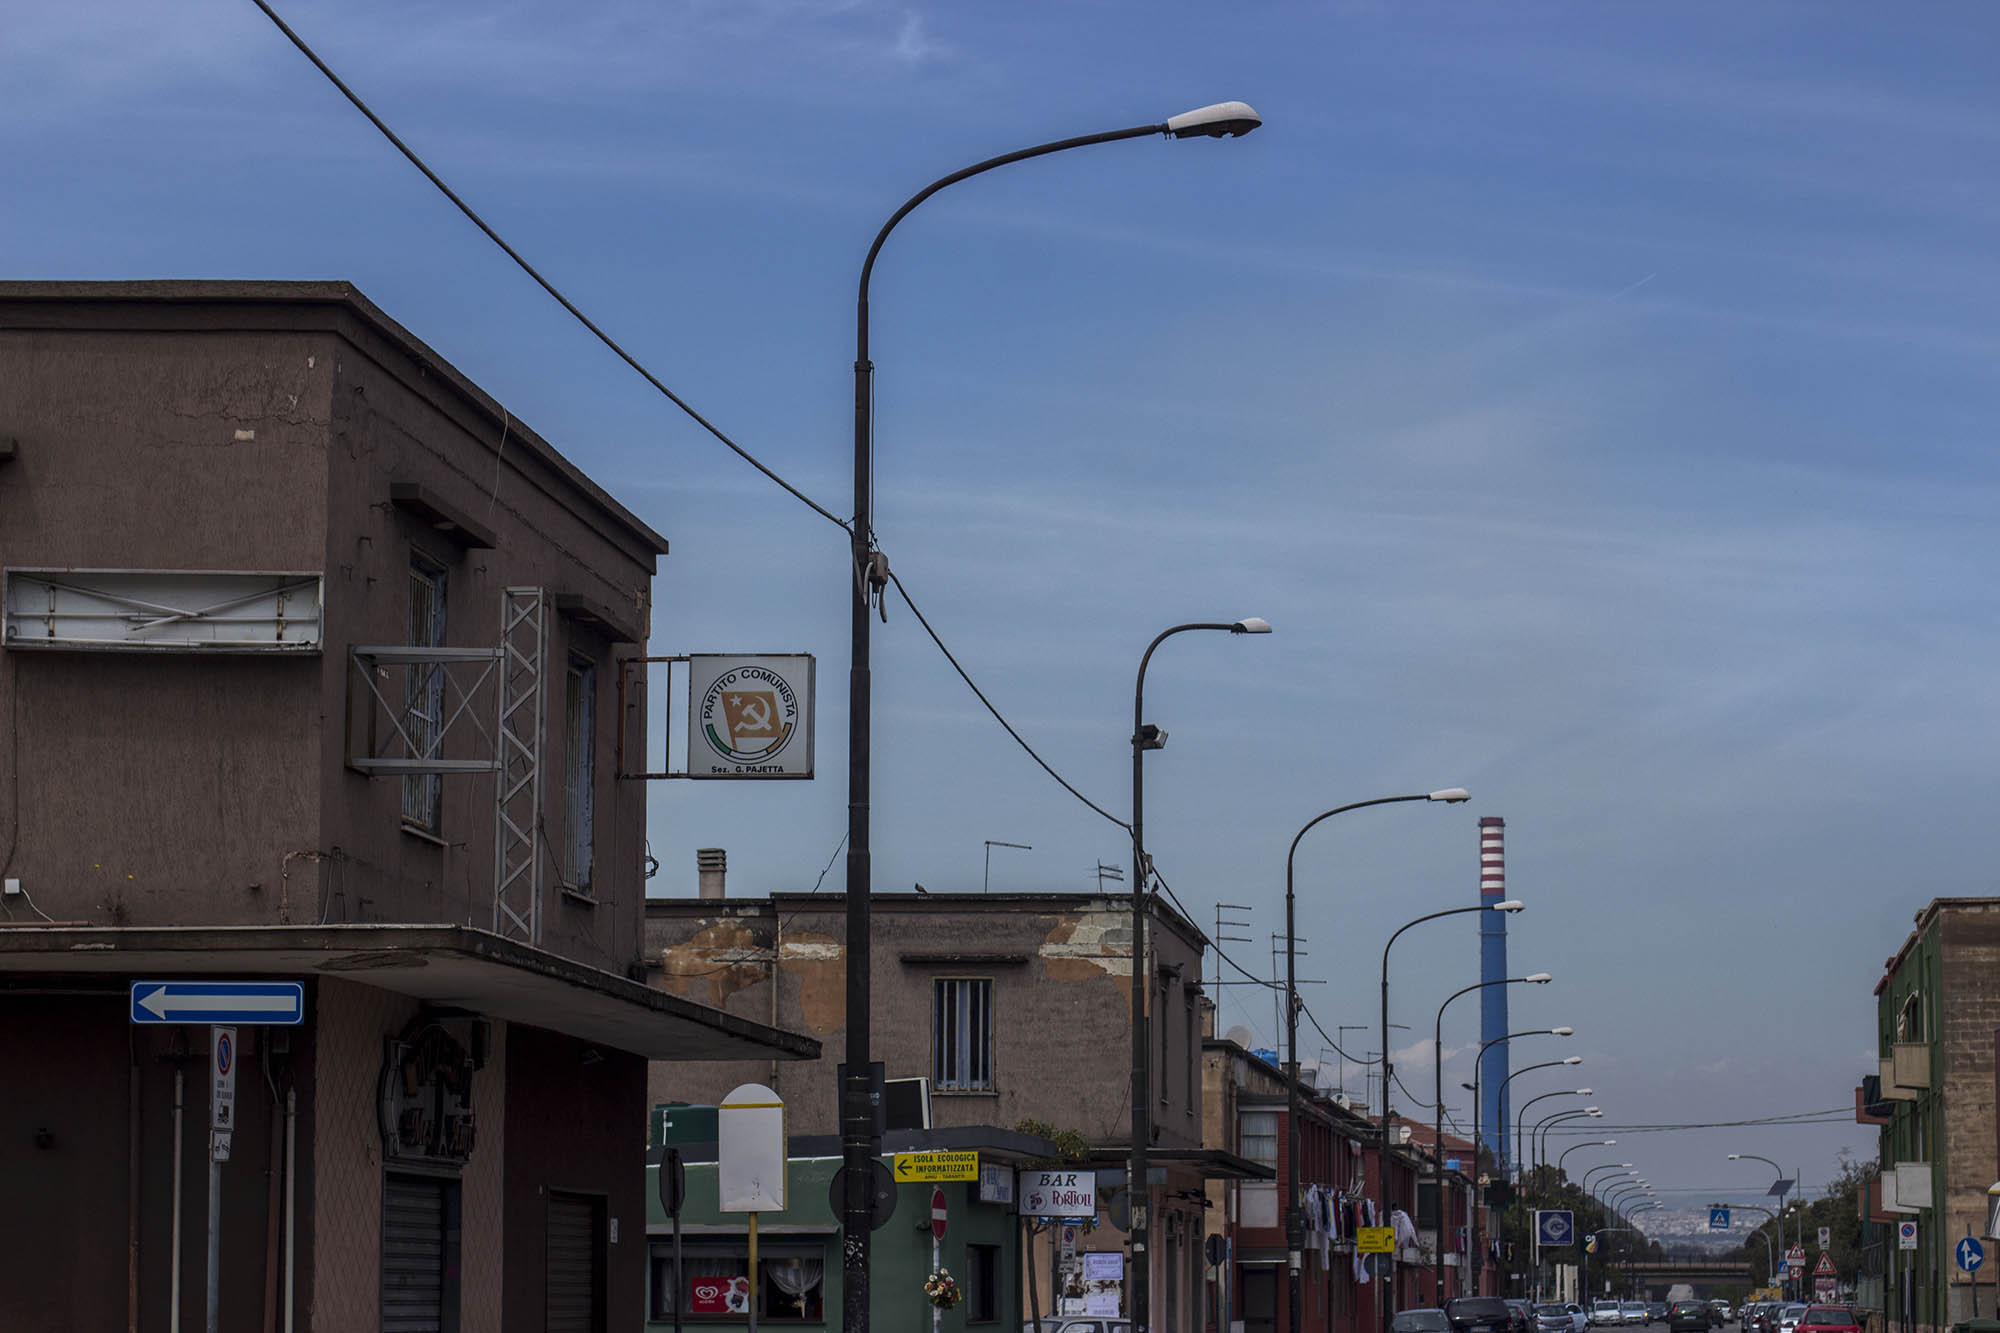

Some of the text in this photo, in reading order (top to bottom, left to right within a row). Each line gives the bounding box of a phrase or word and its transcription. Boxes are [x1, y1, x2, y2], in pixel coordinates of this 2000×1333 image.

[704, 669, 796, 719] PARTITO COMUNISTA
[914, 1153, 976, 1163] ISOLA ECOLOGICA
[916, 1164, 974, 1173] INFORMATIZZATA
[1038, 1174, 1078, 1187] BAR
